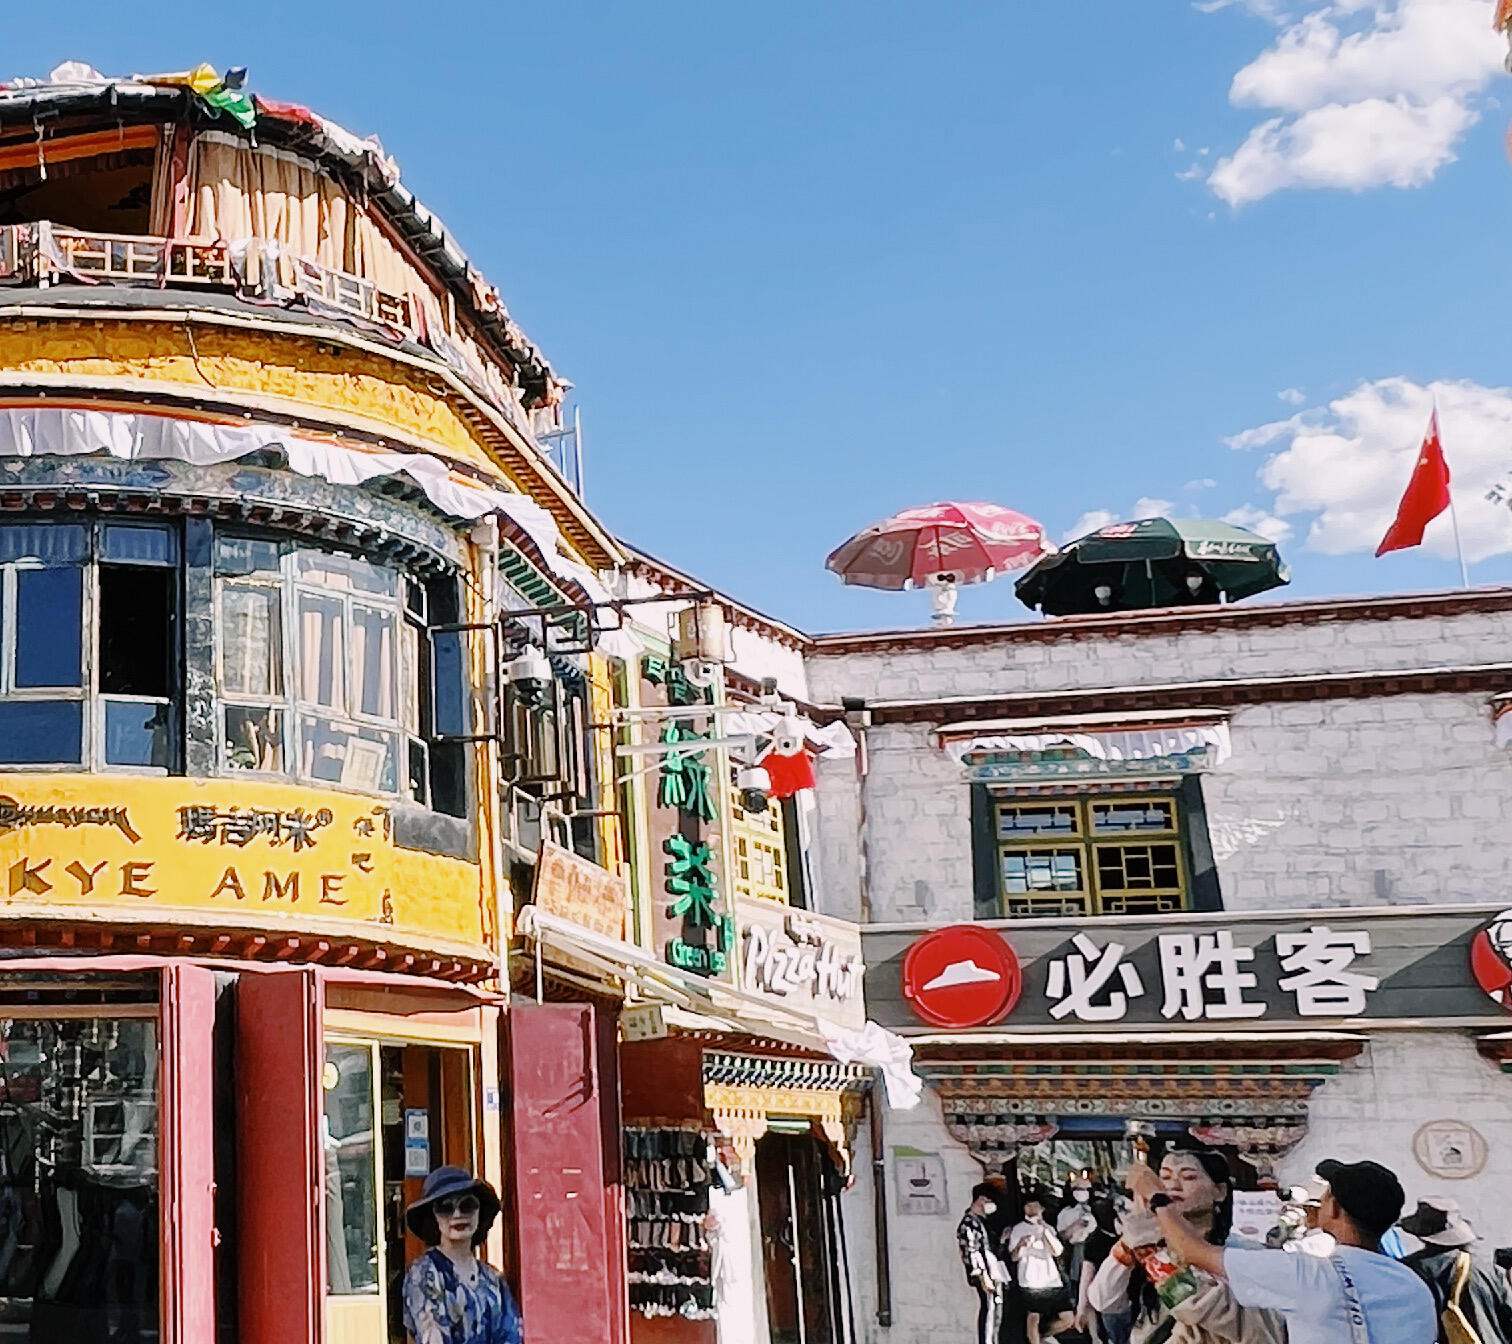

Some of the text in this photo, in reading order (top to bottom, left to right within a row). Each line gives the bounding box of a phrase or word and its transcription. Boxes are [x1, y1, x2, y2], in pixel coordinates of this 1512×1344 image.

[210, 866, 349, 905] AME
[745, 923, 818, 993] Pizza
[817, 938, 867, 999] Hut
[1045, 925, 1379, 1022] 必胜客
